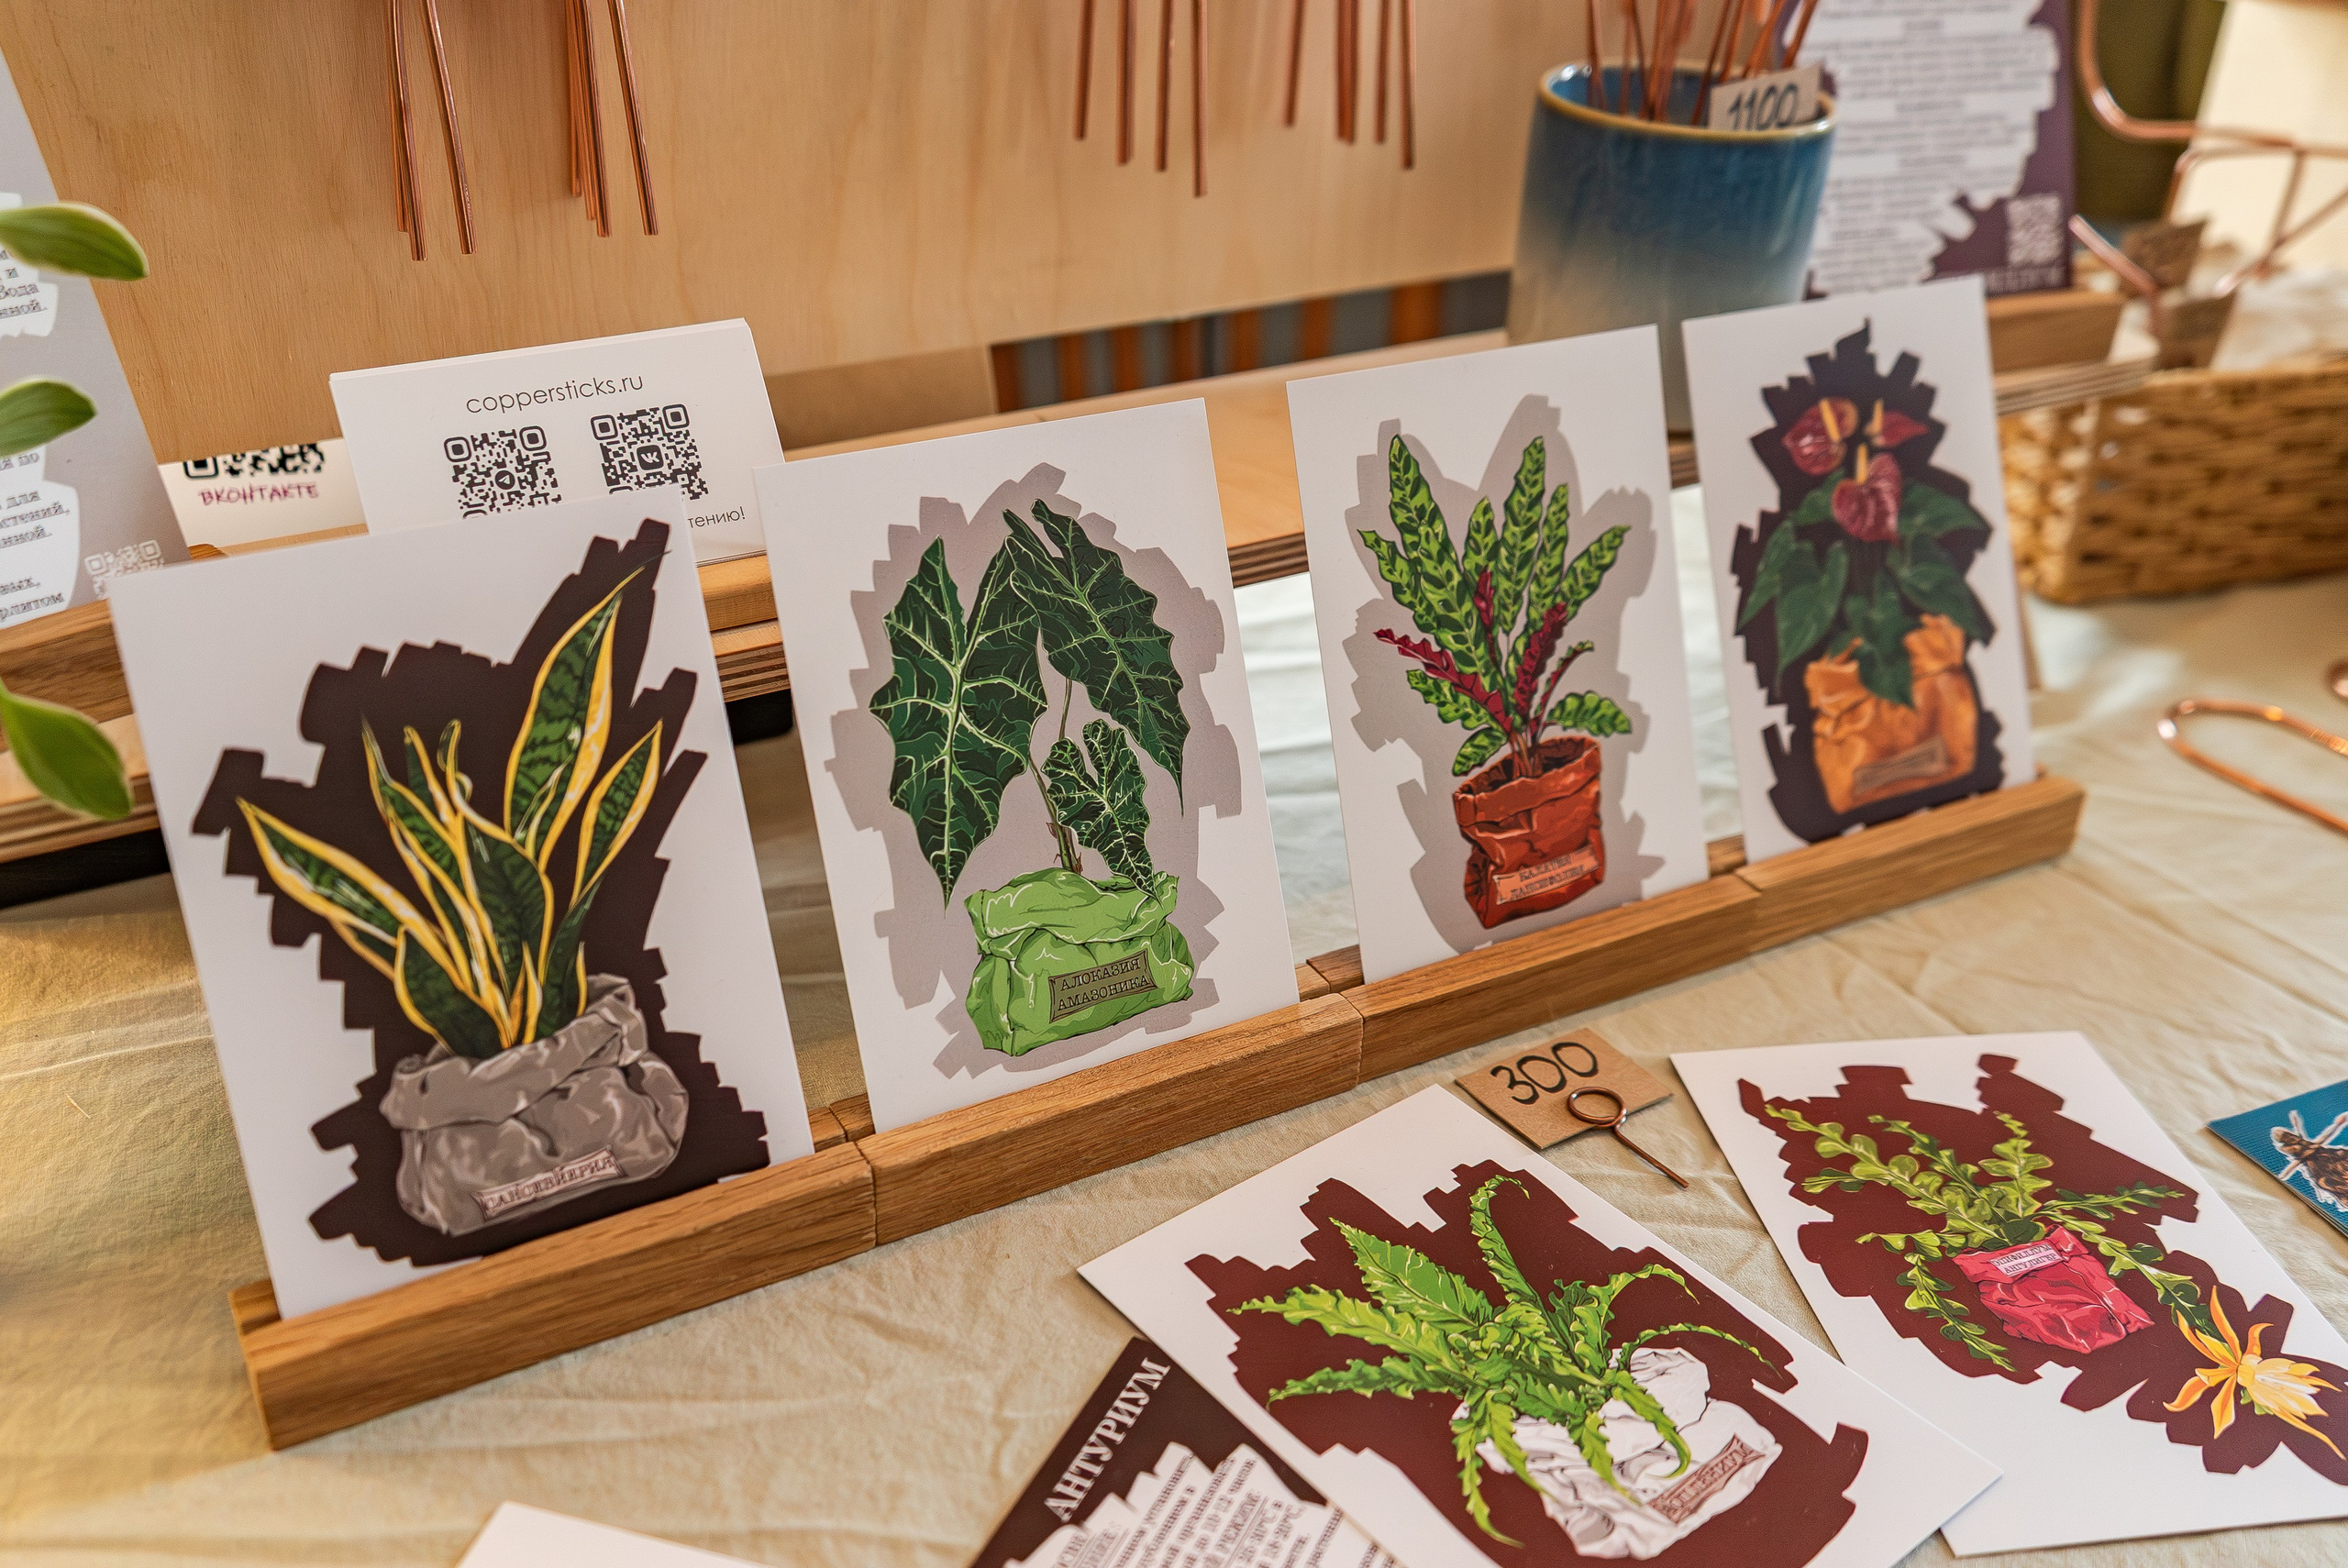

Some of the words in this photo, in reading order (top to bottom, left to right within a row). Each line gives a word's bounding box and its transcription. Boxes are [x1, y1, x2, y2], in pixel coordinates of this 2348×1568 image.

[1727, 82, 1799, 130] 1100
[466, 375, 643, 414] coppersticks.ru
[198, 481, 318, 505] ВКОНТАКТЕ
[687, 505, 745, 528] тению!
[1058, 975, 1150, 1010] АМАЗОНИКА
[1060, 958, 1141, 991] АЛОКАЗИЯ
[1490, 1042, 1599, 1105] 300
[1044, 1357, 1171, 1522] АНТУРИУМ
